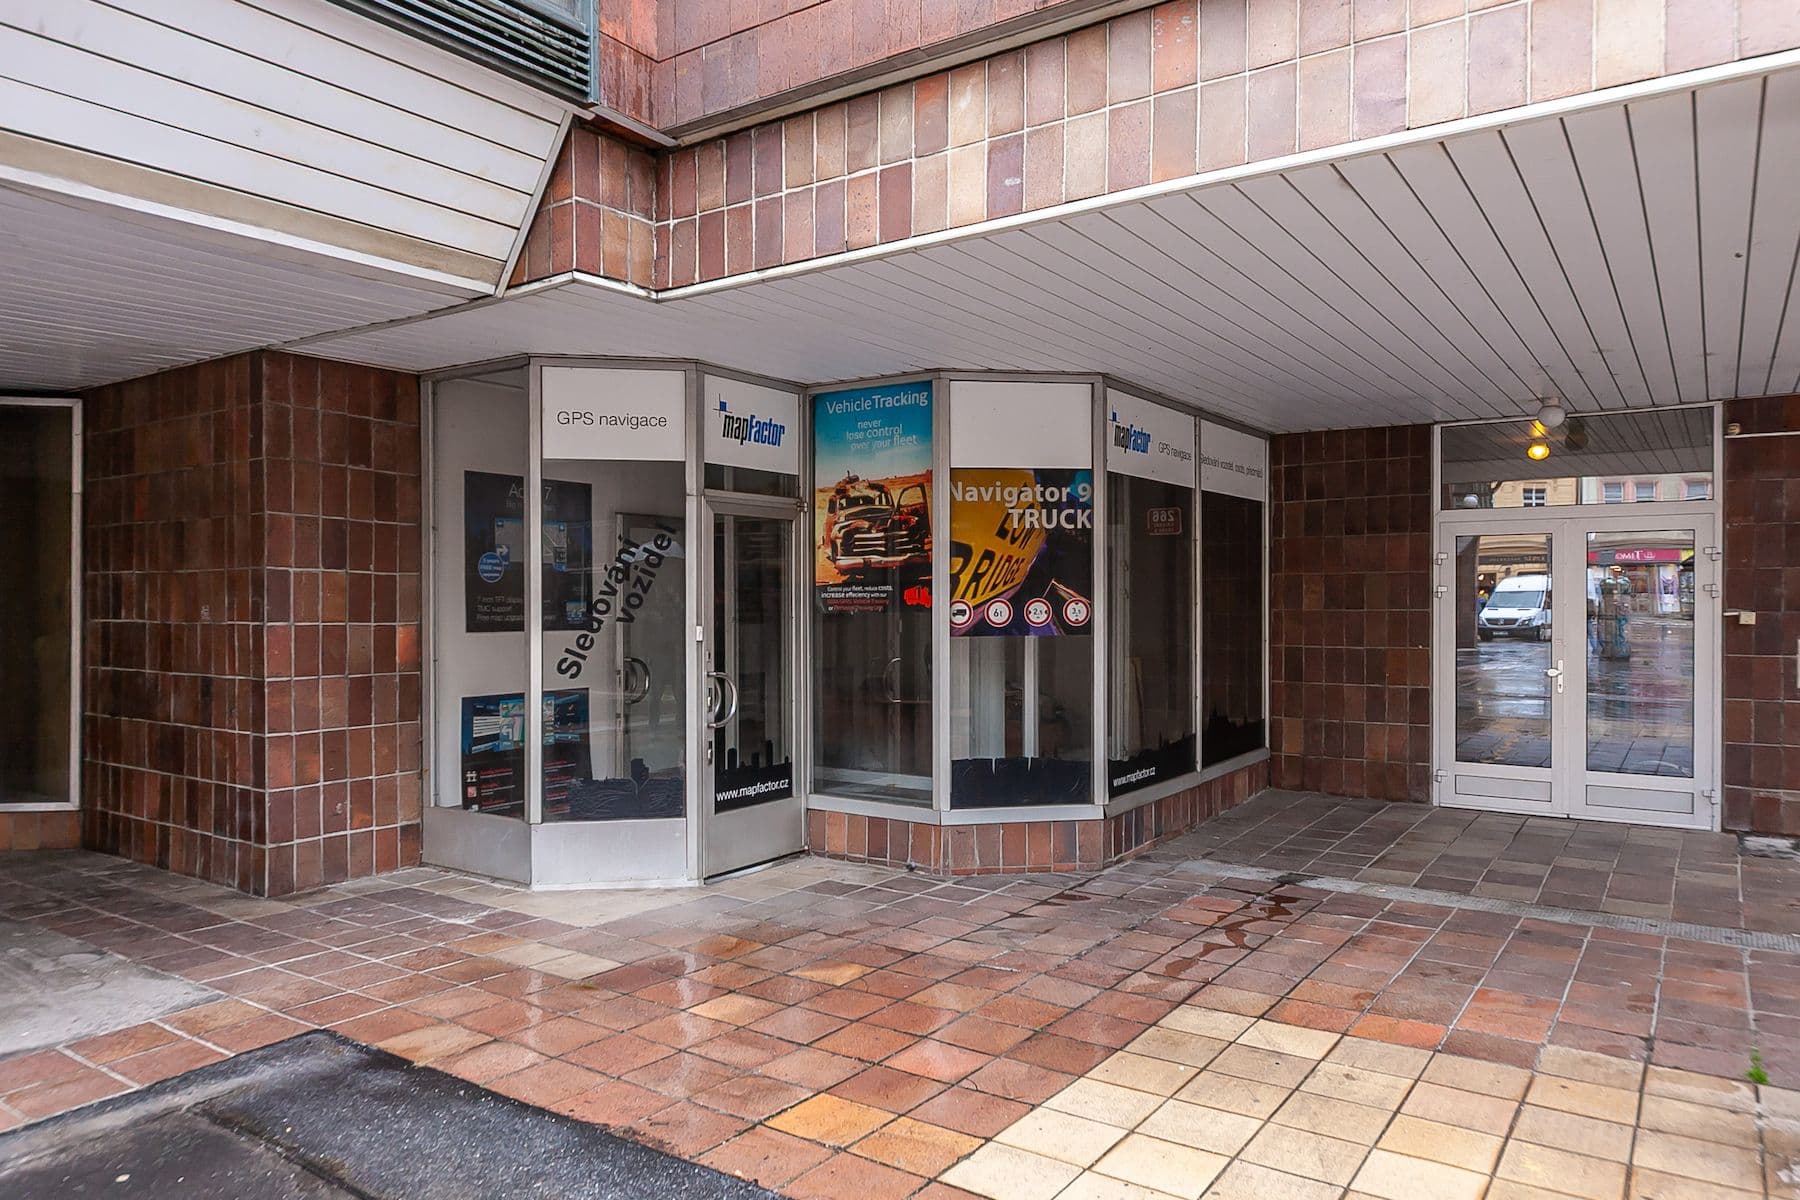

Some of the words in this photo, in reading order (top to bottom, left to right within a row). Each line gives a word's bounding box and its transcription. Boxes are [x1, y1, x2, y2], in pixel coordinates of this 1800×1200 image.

[826, 396, 872, 414] Vehicle
[872, 391, 928, 409] Tracking
[556, 411, 594, 426] GPS
[599, 413, 668, 429] navigace
[722, 414, 785, 447] mapFactor
[857, 419, 881, 429] never
[846, 431, 864, 440] lose
[866, 424, 902, 438] control
[894, 434, 918, 447] fleet
[1113, 424, 1151, 454] mapFactor
[1158, 441, 1171, 456] GPS
[1171, 446, 1192, 461] navigace
[950, 481, 1070, 507] Navigator
[1077, 482, 1091, 502] 9
[1007, 508, 1092, 529] TRUCK
[616, 522, 677, 623] vozidel
[557, 534, 641, 679] Sledování
[716, 779, 789, 801] www.mapfactor.cz
